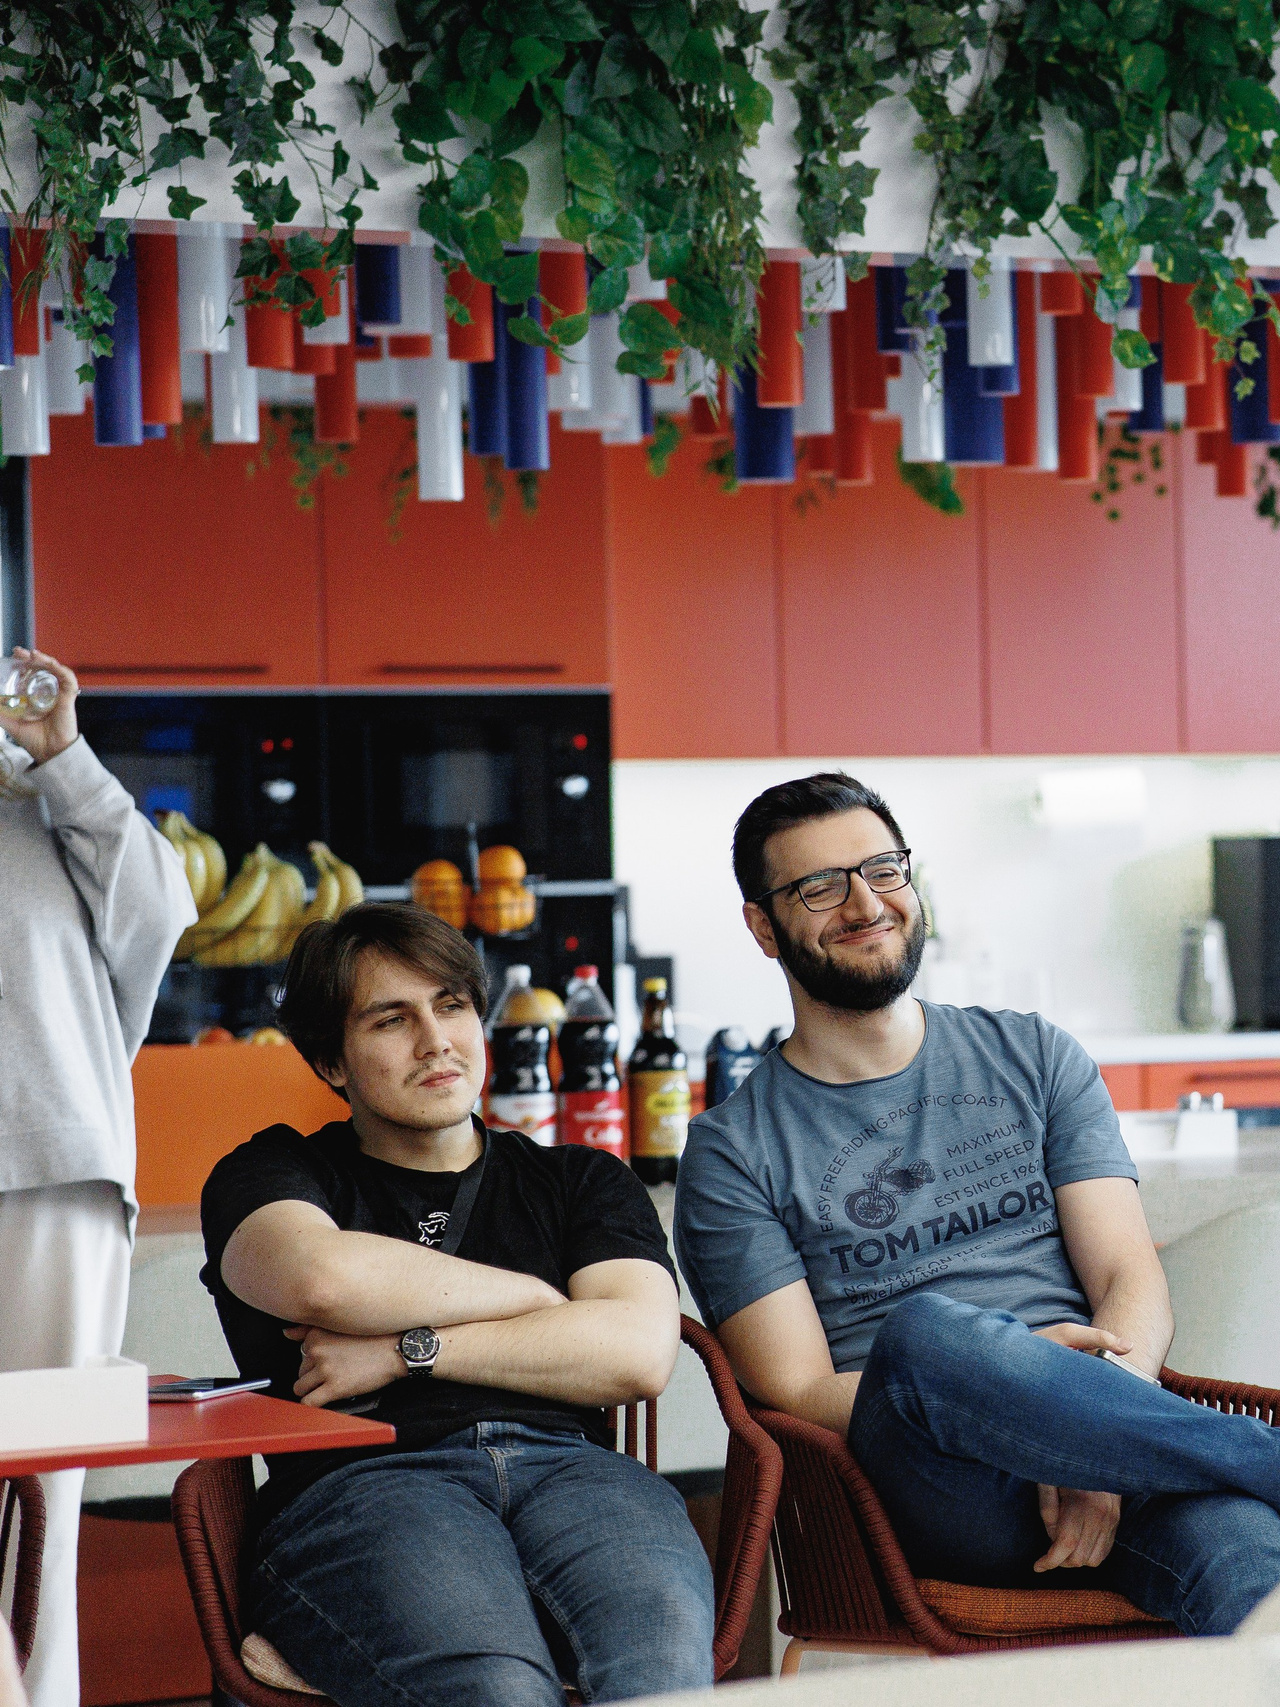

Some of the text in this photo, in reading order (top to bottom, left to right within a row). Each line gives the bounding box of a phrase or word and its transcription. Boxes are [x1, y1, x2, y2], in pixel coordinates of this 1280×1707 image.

[942, 1139, 1035, 1182] FULL SPEED
[946, 1119, 1026, 1159] MAXIMUM
[817, 1093, 1008, 1233] EASY FREE RIDING PACIFIC COAST
[934, 1190, 961, 1208] EST
[963, 1172, 1012, 1198] SINCE
[829, 1180, 1051, 1274] TOM TAILOR
